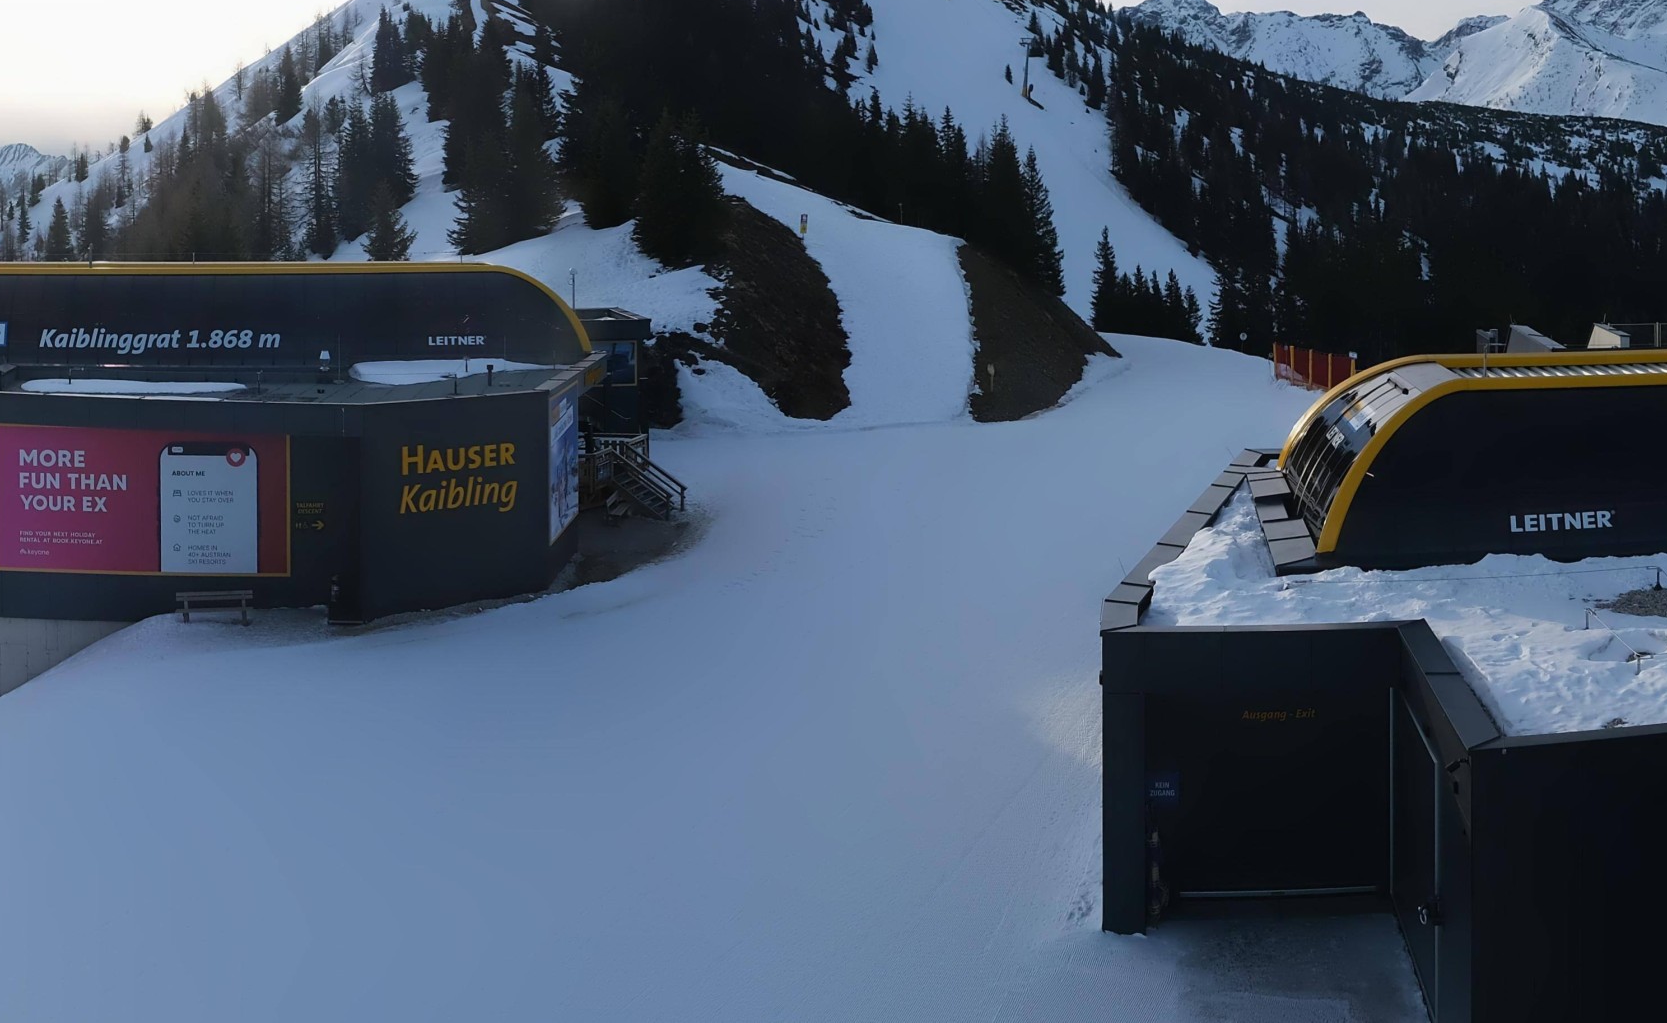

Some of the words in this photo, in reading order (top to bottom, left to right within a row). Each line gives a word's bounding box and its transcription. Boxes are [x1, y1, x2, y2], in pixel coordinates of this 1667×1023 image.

[39, 328, 181, 355] Kaiblinggrat
[186, 329, 254, 349] 1.868
[258, 333, 281, 348] m
[428, 336, 485, 346] LEITNER
[19, 449, 85, 467] MORE
[402, 443, 515, 475] HAUSER
[19, 472, 60, 489] FUN
[67, 473, 127, 491] THAN
[20, 495, 76, 511] YOUR
[82, 496, 107, 512] EX
[400, 476, 518, 514] Kaibling
[1510, 510, 1613, 533] LEITNER
[27, 548, 50, 556] keyone
[1242, 710, 1287, 722] Ausgang
[1295, 708, 1315, 718] Exit
[1150, 789, 1175, 797] ZUGANG
